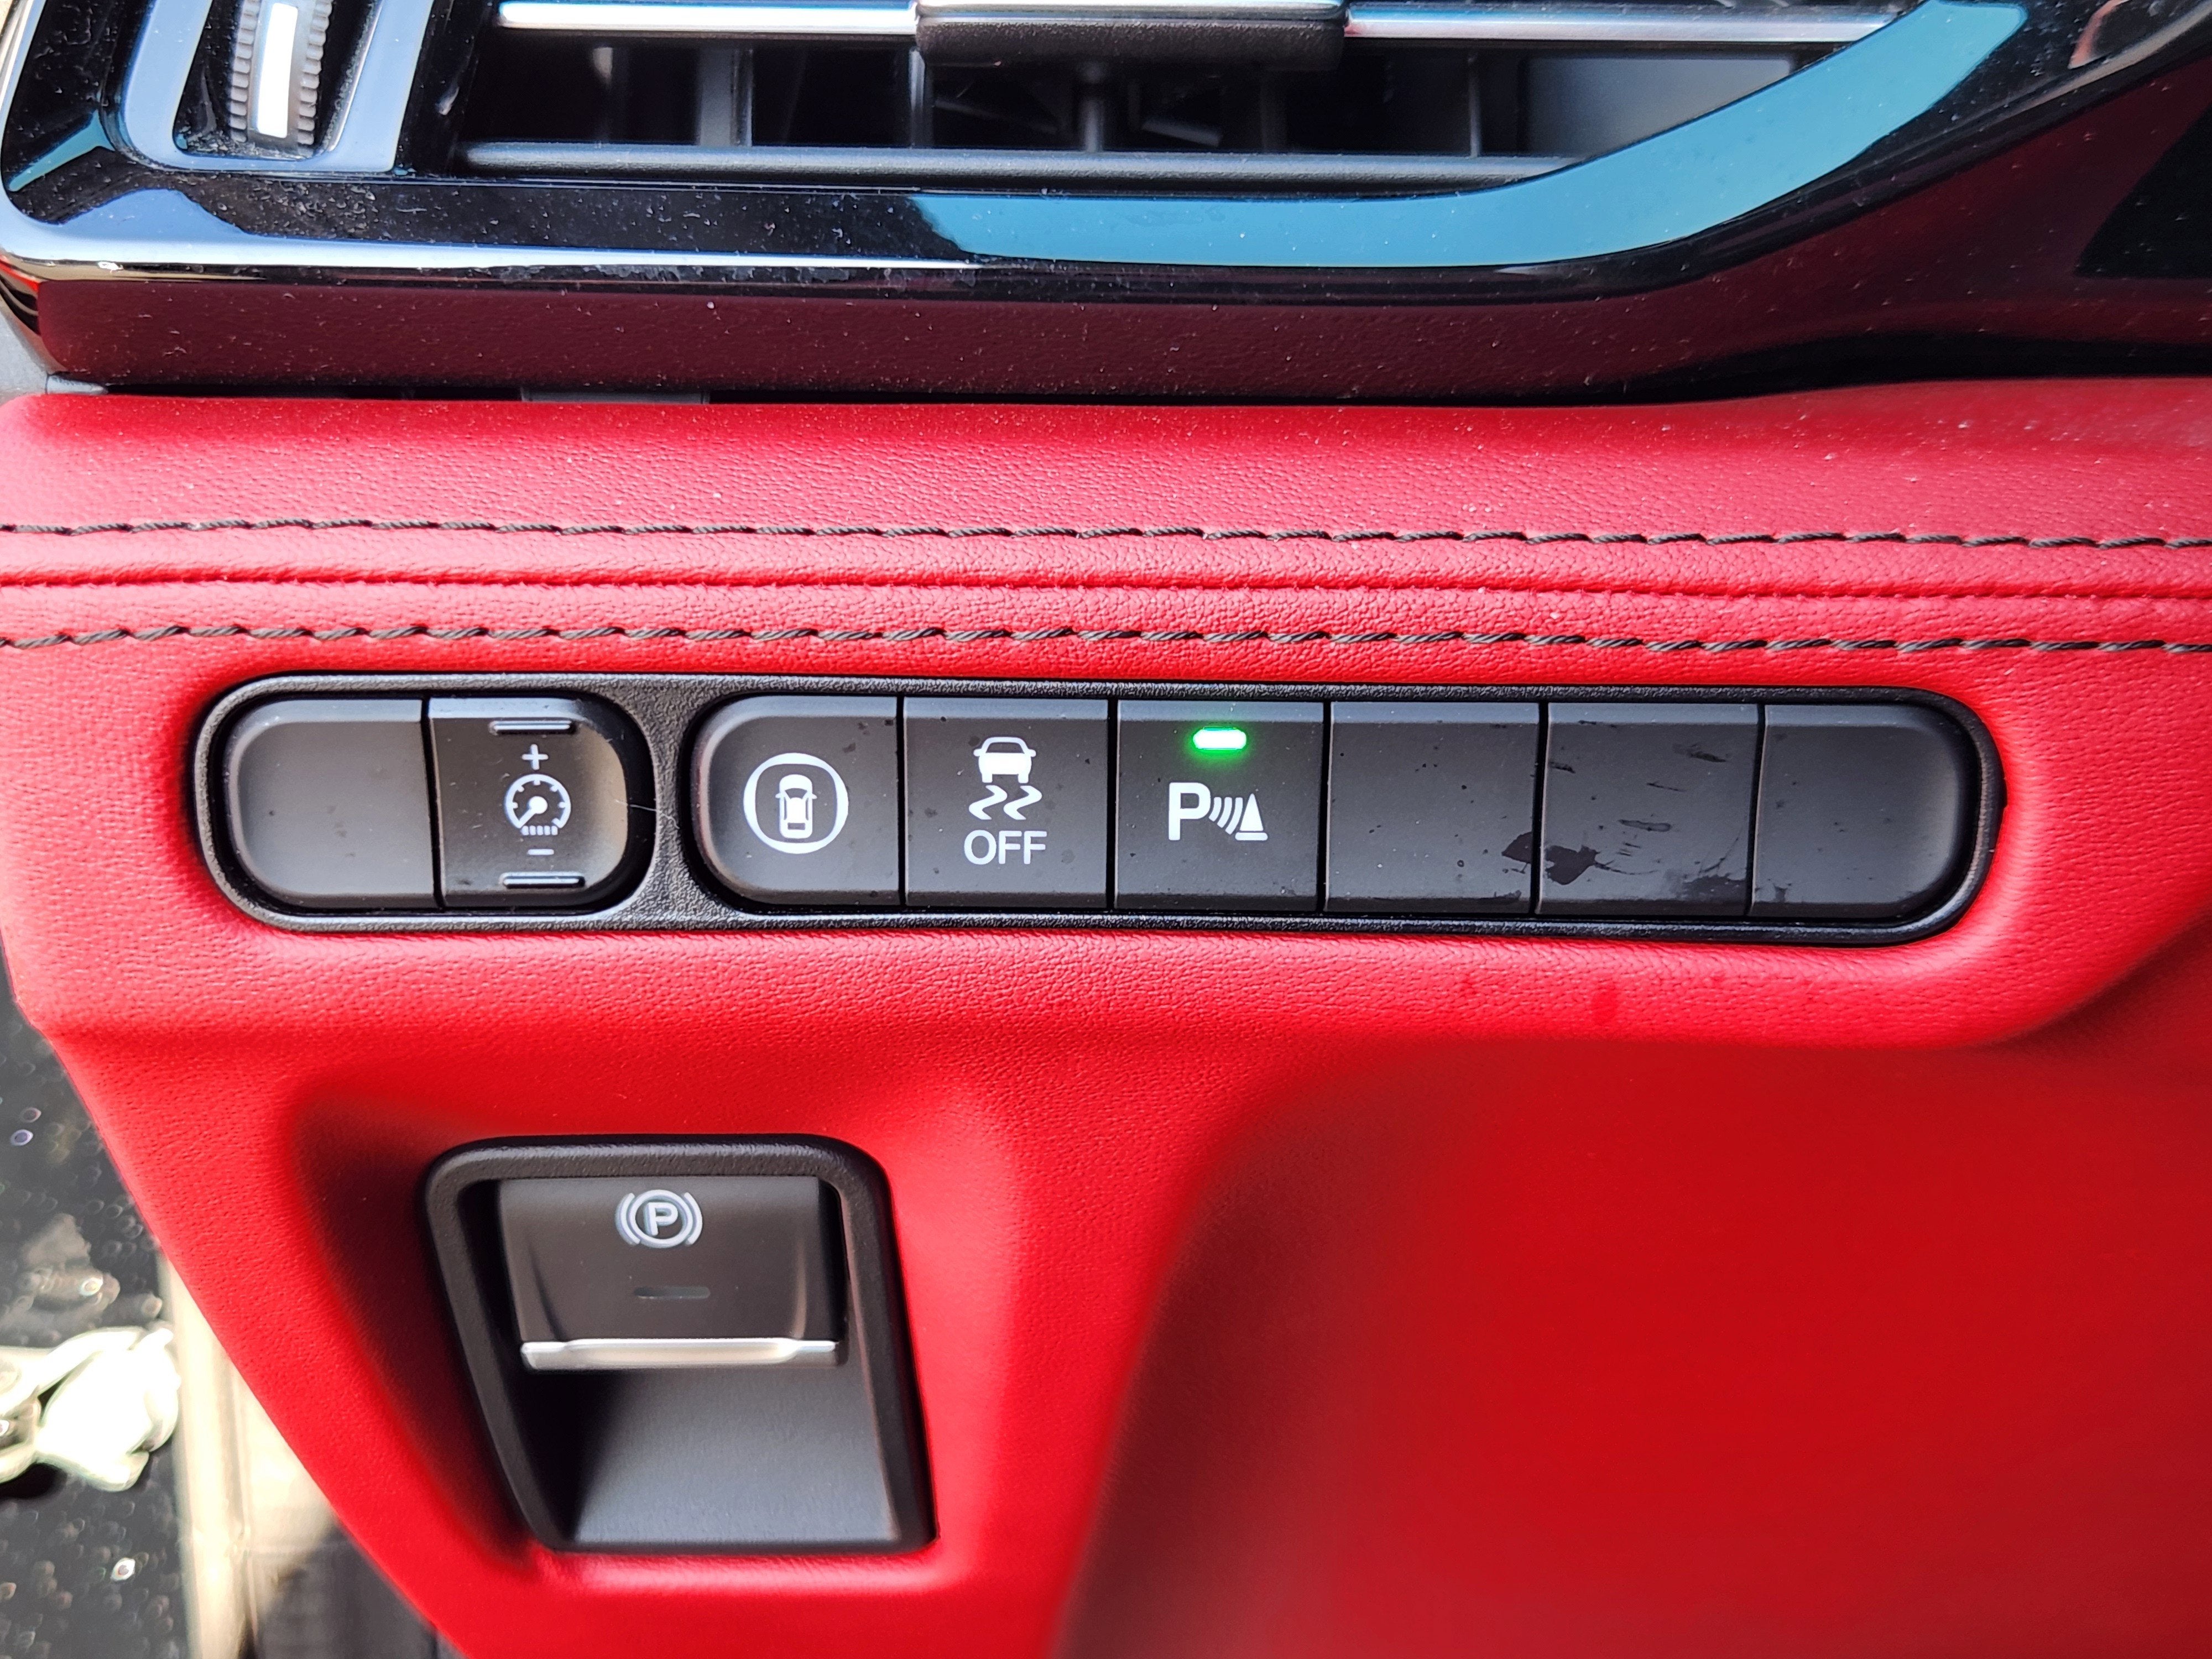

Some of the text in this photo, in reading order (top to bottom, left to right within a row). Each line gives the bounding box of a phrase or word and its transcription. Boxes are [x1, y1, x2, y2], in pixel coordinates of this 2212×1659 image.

[1168, 782, 1212, 841] P
[964, 830, 1047, 865] OFF
[643, 1202, 679, 1236] P
